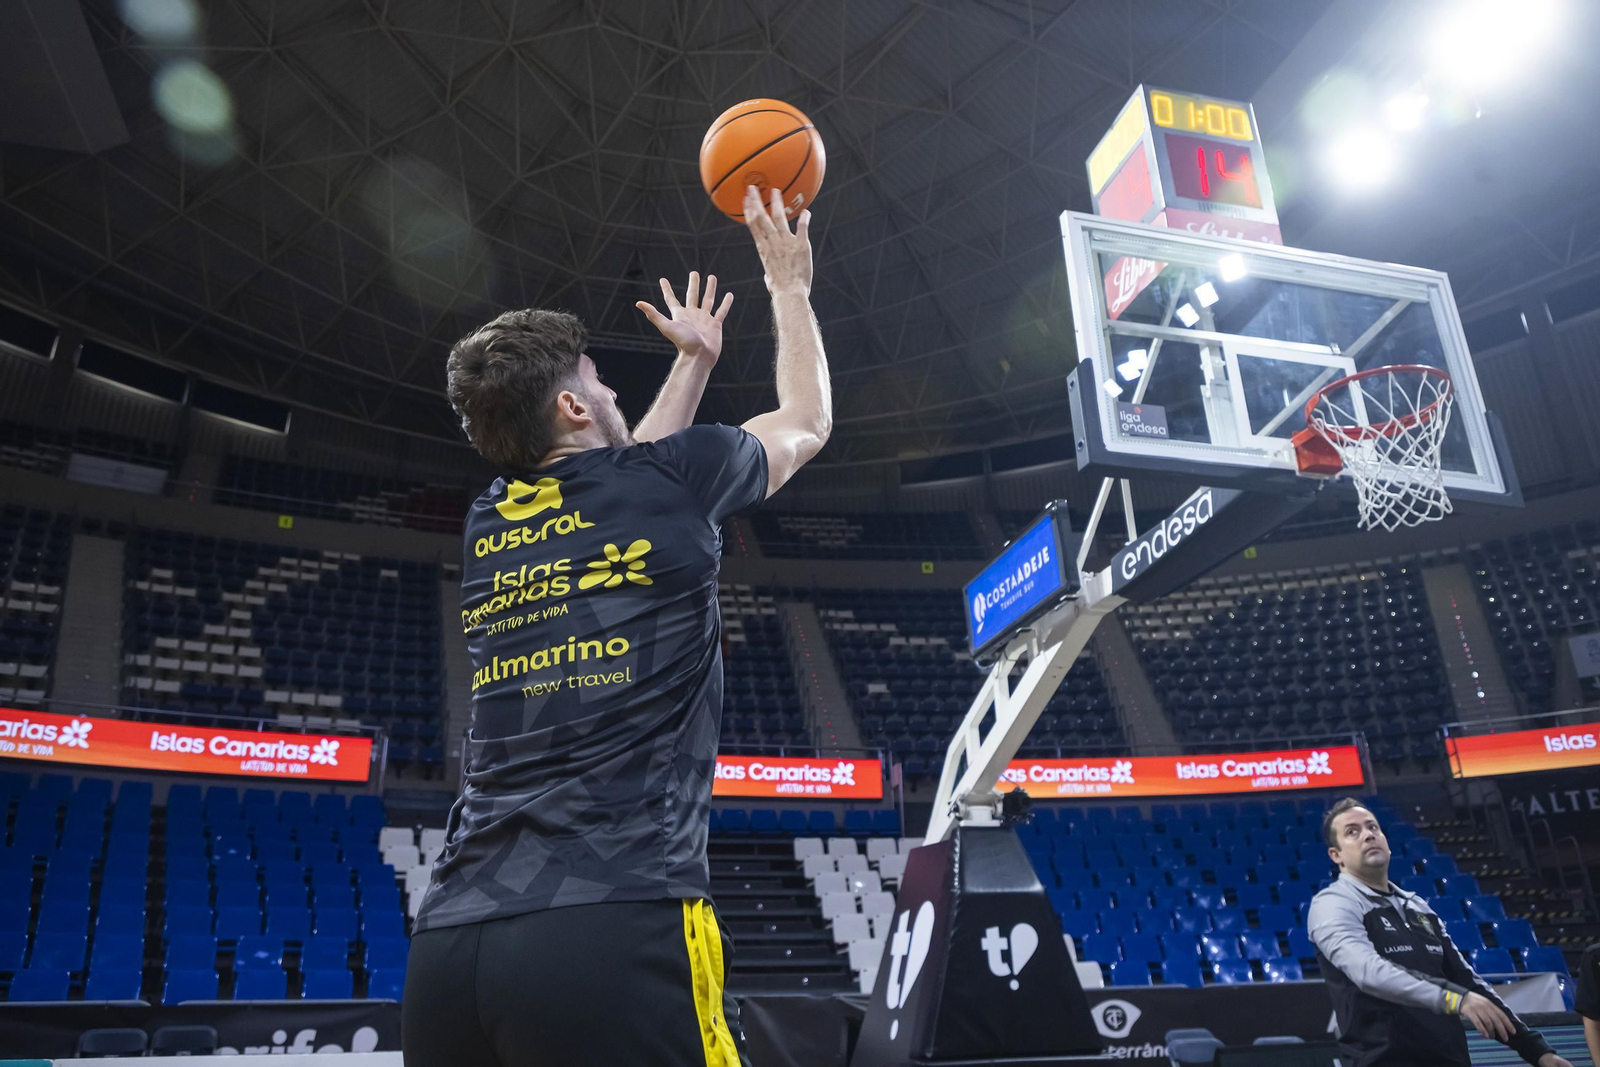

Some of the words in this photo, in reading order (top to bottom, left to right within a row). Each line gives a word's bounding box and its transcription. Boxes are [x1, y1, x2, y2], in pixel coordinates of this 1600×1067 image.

[1197, 146, 1254, 204] 14
[1120, 410, 1141, 423] liga
[1122, 423, 1167, 435] endesa
[475, 510, 596, 557] austral
[1121, 490, 1213, 580] endesa
[493, 559, 572, 592] Islas
[462, 576, 571, 634] Canarias
[527, 611, 540, 624] DE
[542, 603, 569, 620] VIDA
[472, 636, 630, 692] zulmarino
[522, 680, 562, 698] new
[566, 667, 632, 688] travel
[150, 731, 205, 753] Islas
[209, 736, 310, 760] Canarias
[1543, 733, 1597, 753] Islas
[748, 763, 832, 782] Canarias
[1029, 765, 1110, 783] Canarias
[1176, 762, 1220, 779] Islas
[1221, 757, 1306, 777] Canarias
